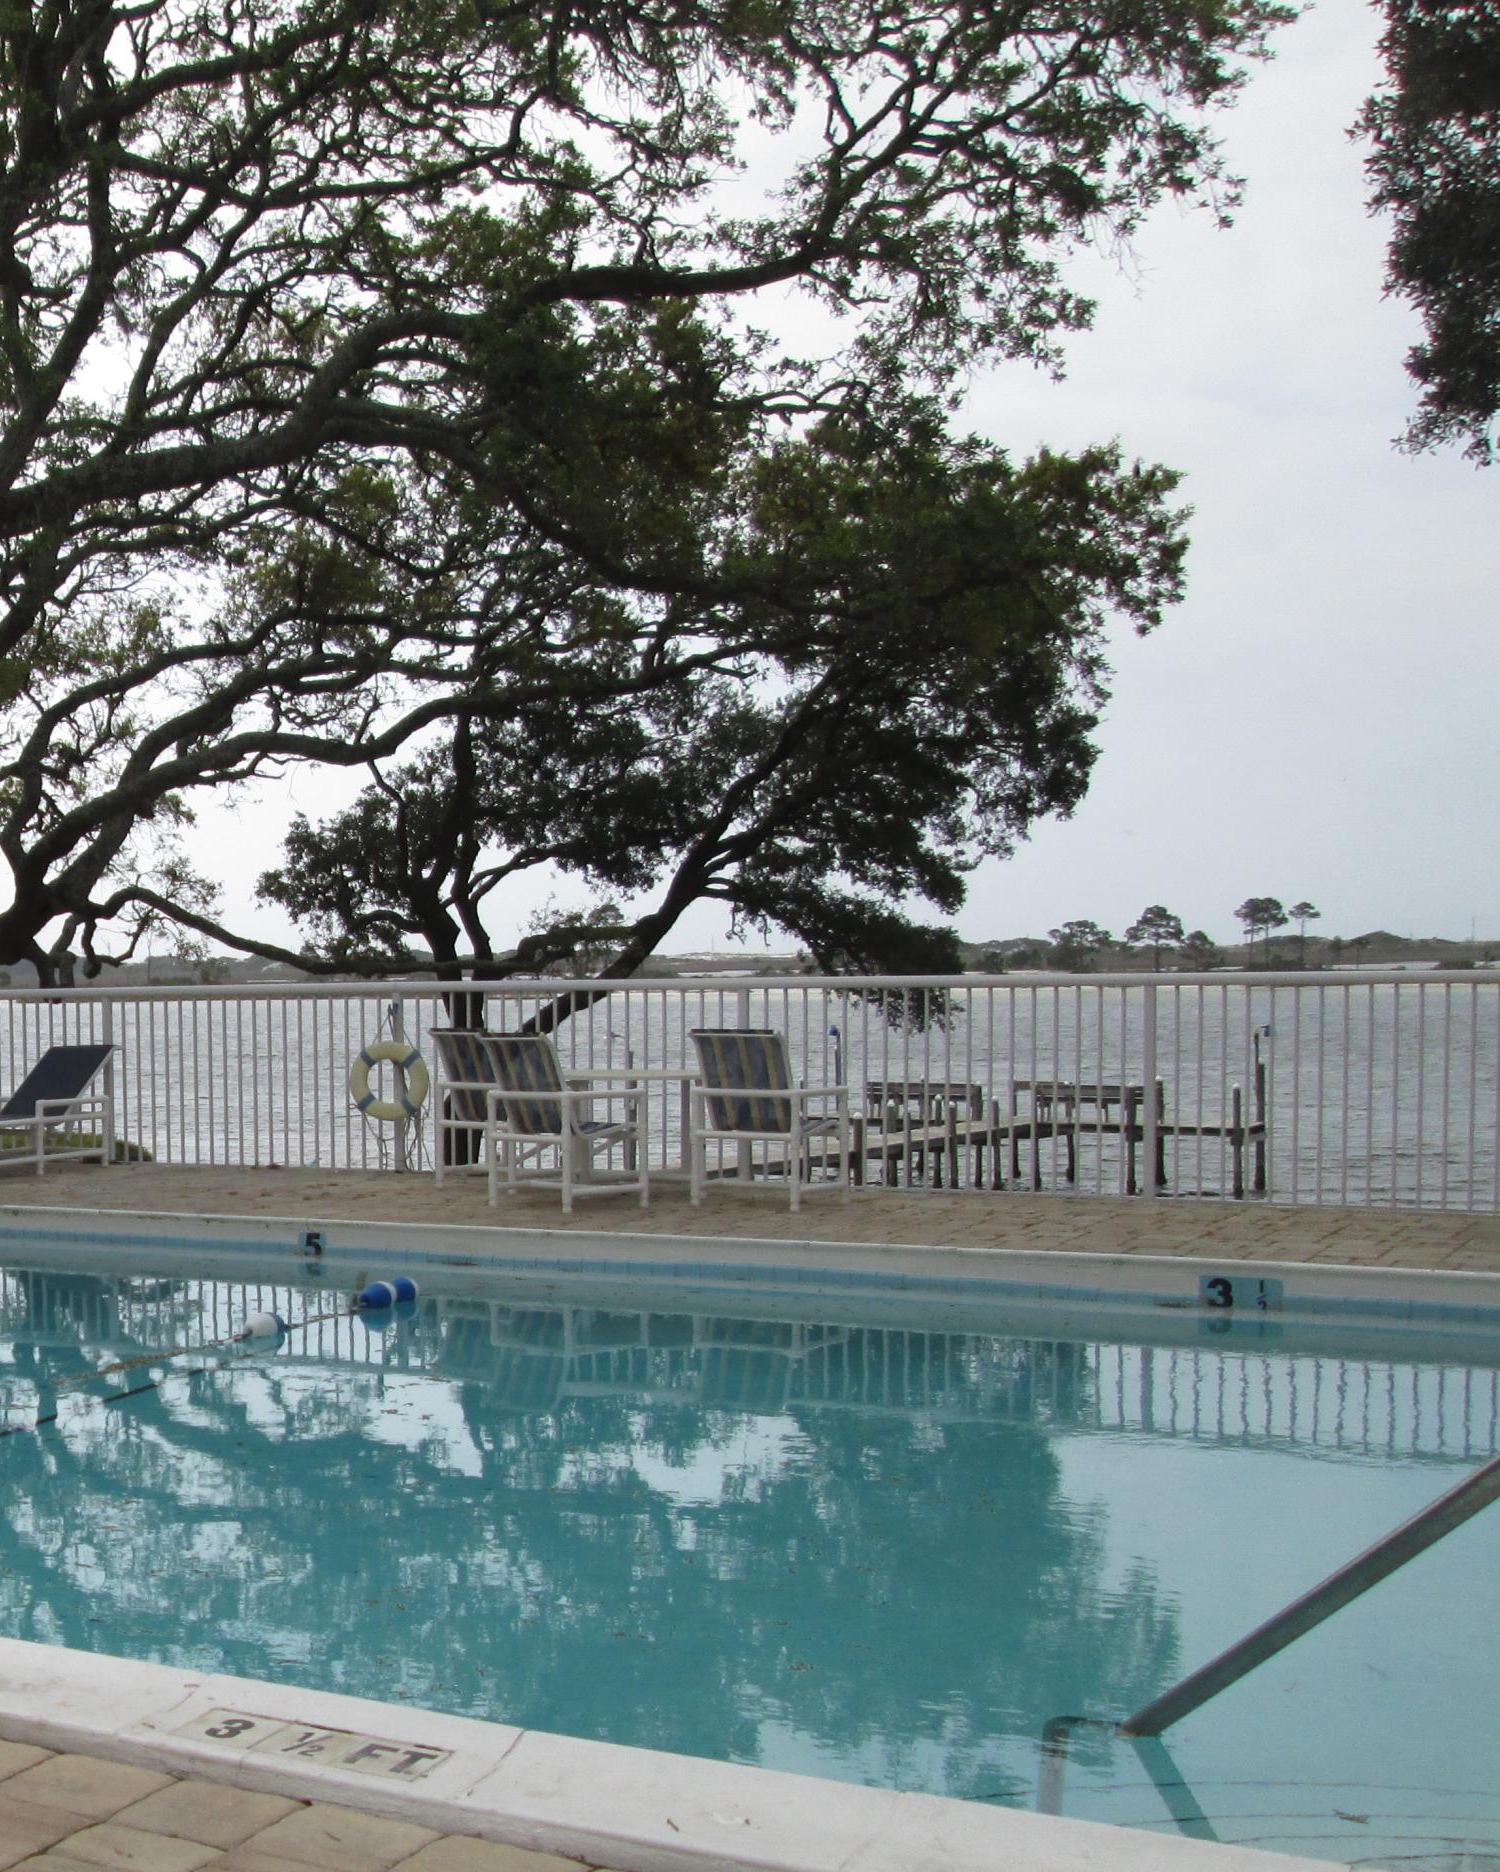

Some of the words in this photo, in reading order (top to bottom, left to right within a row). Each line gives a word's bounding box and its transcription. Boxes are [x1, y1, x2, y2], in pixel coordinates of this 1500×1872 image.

[305, 1232, 322, 1256] 5
[1207, 1278, 1234, 1308] 3
[205, 1719, 255, 1738] 3
[341, 1743, 438, 1774] FT
